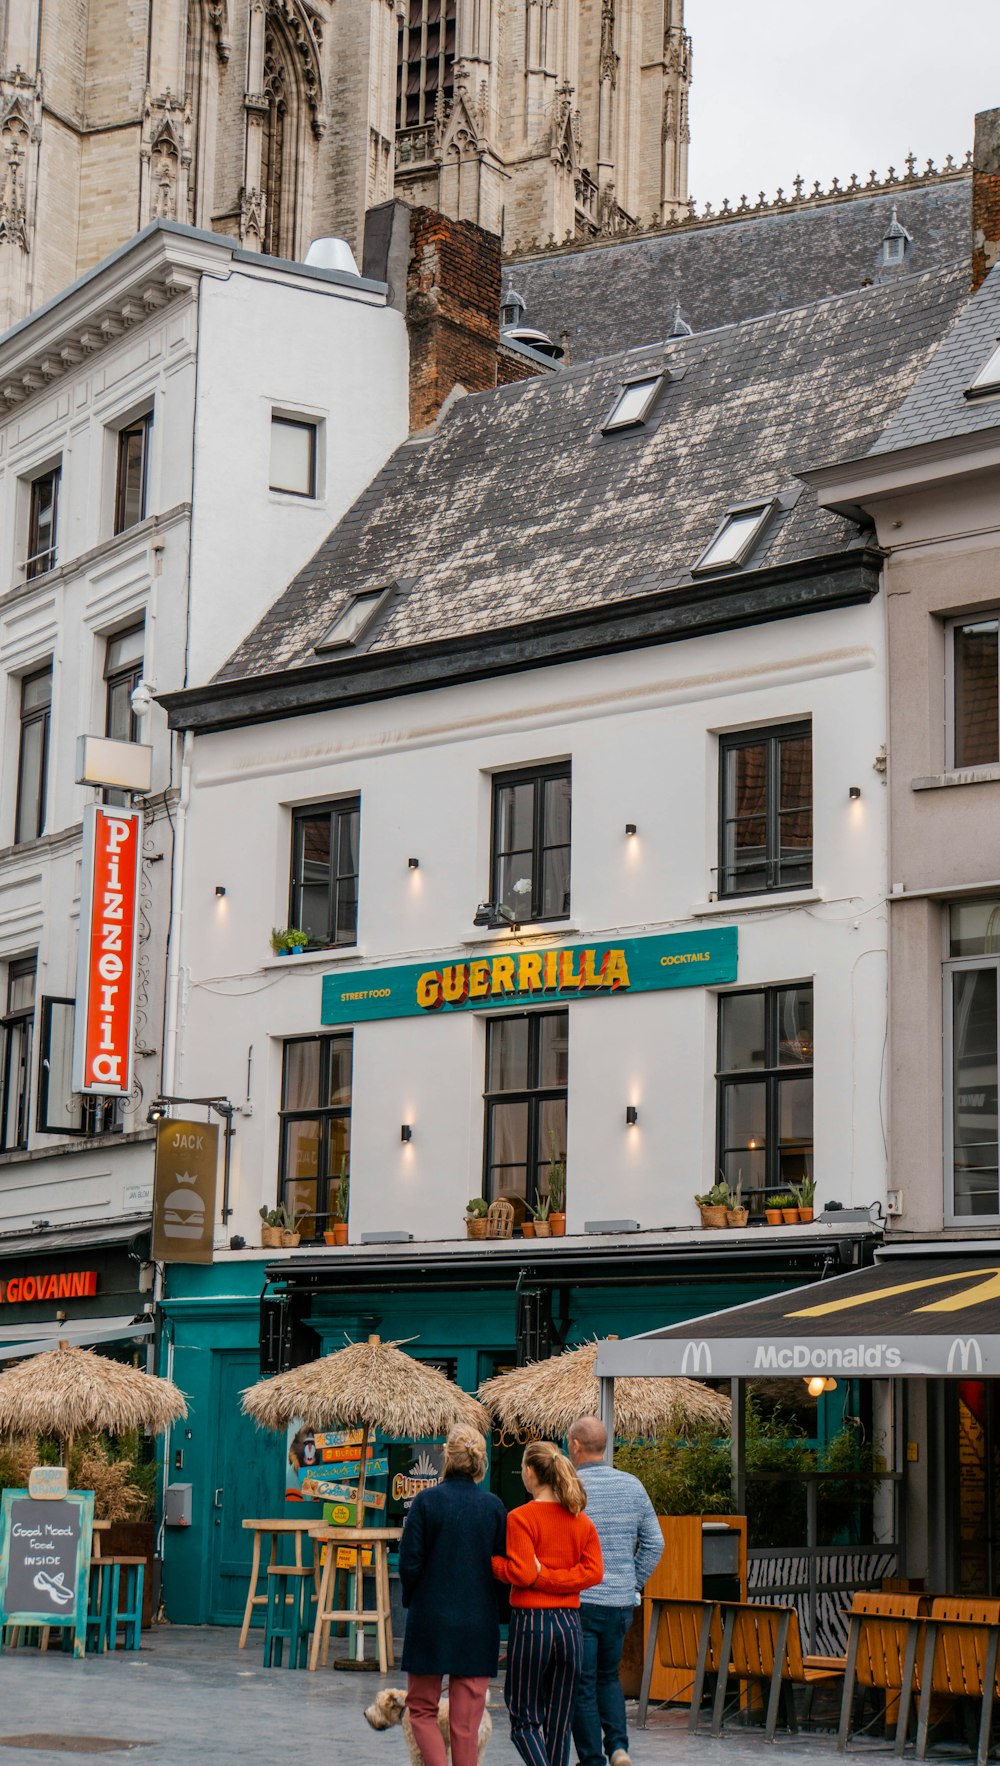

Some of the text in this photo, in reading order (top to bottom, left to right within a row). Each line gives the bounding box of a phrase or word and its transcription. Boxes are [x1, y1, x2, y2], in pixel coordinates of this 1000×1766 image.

[92, 820, 130, 1081] Pizzeria
[660, 952, 711, 966] COCKTAILS
[416, 949, 630, 1009] GUERRILLA
[341, 988, 391, 1002] STREET FOOD
[172, 1133, 204, 1149] JACK
[7, 1271, 97, 1303] GIOVANNI
[754, 1344, 901, 1369] McDonald's
[12, 1523, 73, 1537] Good Mood
[30, 1539, 55, 1549] Food
[24, 1556, 60, 1565] INSIDE
